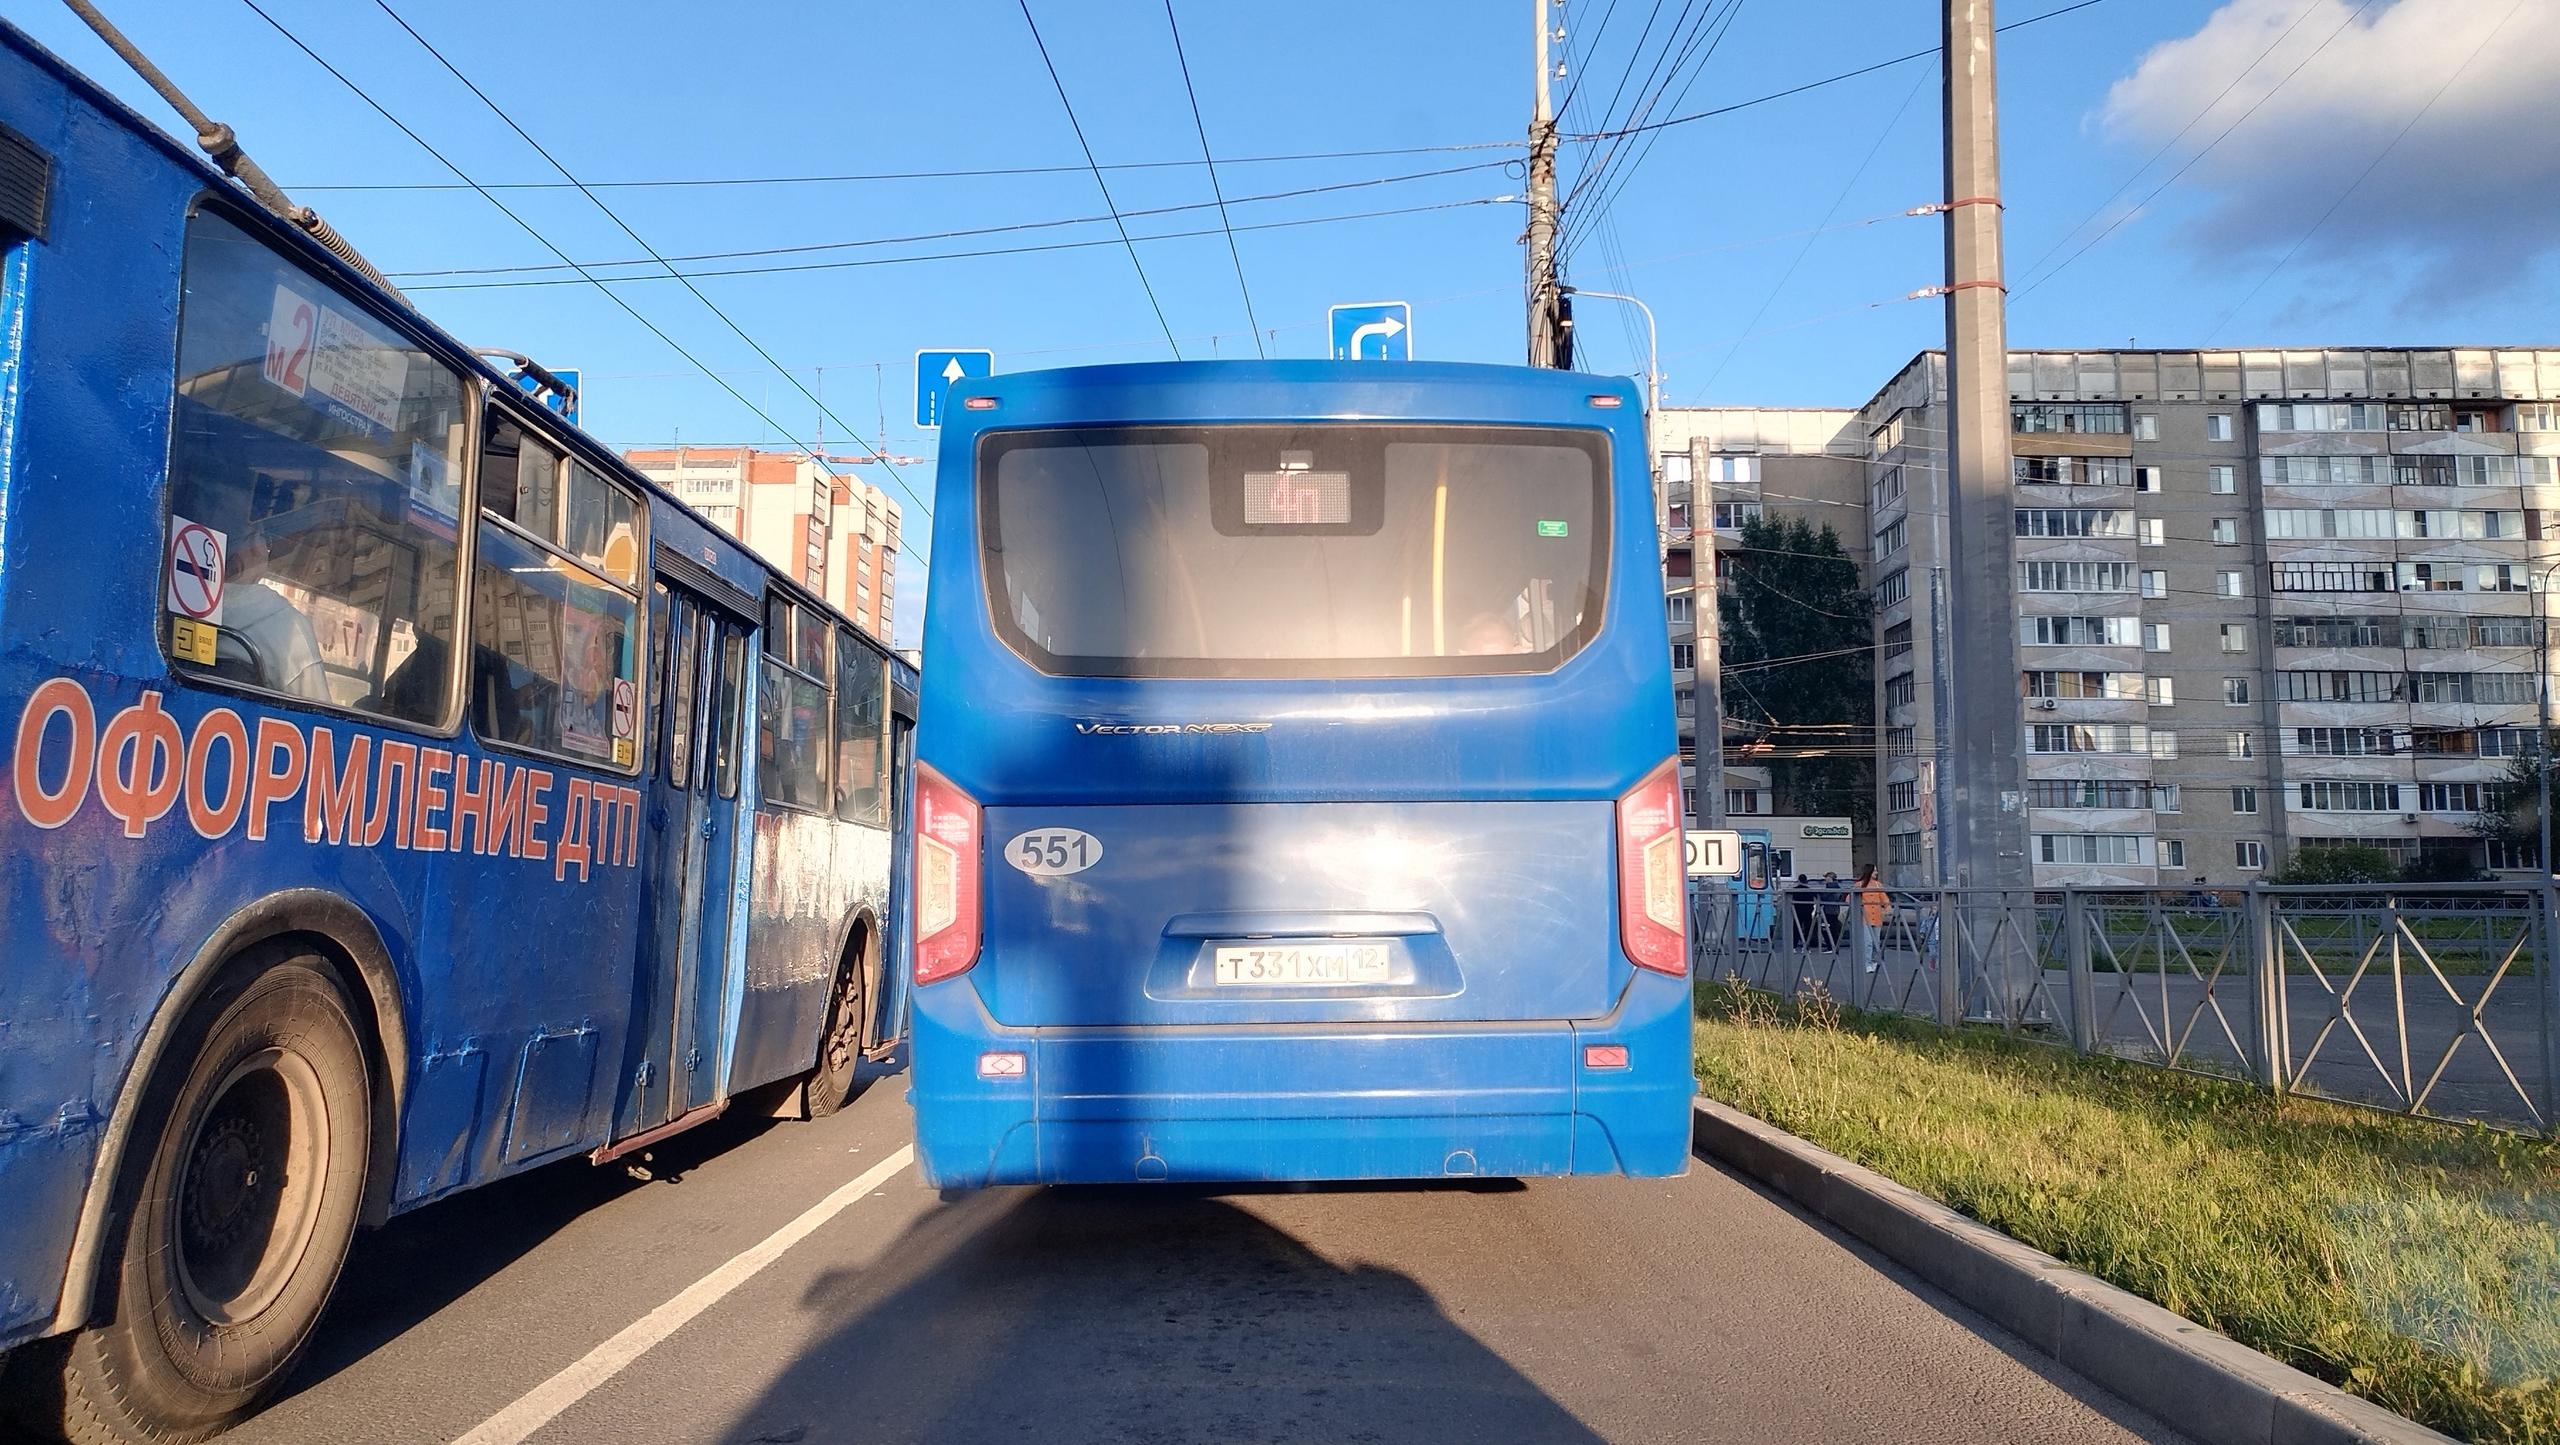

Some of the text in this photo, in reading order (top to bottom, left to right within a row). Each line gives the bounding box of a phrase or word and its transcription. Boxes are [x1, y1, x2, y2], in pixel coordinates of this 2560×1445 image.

[330, 383, 376, 416] ДЕВЯТЫЙ
[14, 677, 553, 860] ОФОРМЛЕНИЕ
[555, 777, 641, 882] ДТП
[1021, 834, 1087, 869] 551
[1352, 948, 1378, 969] 12
